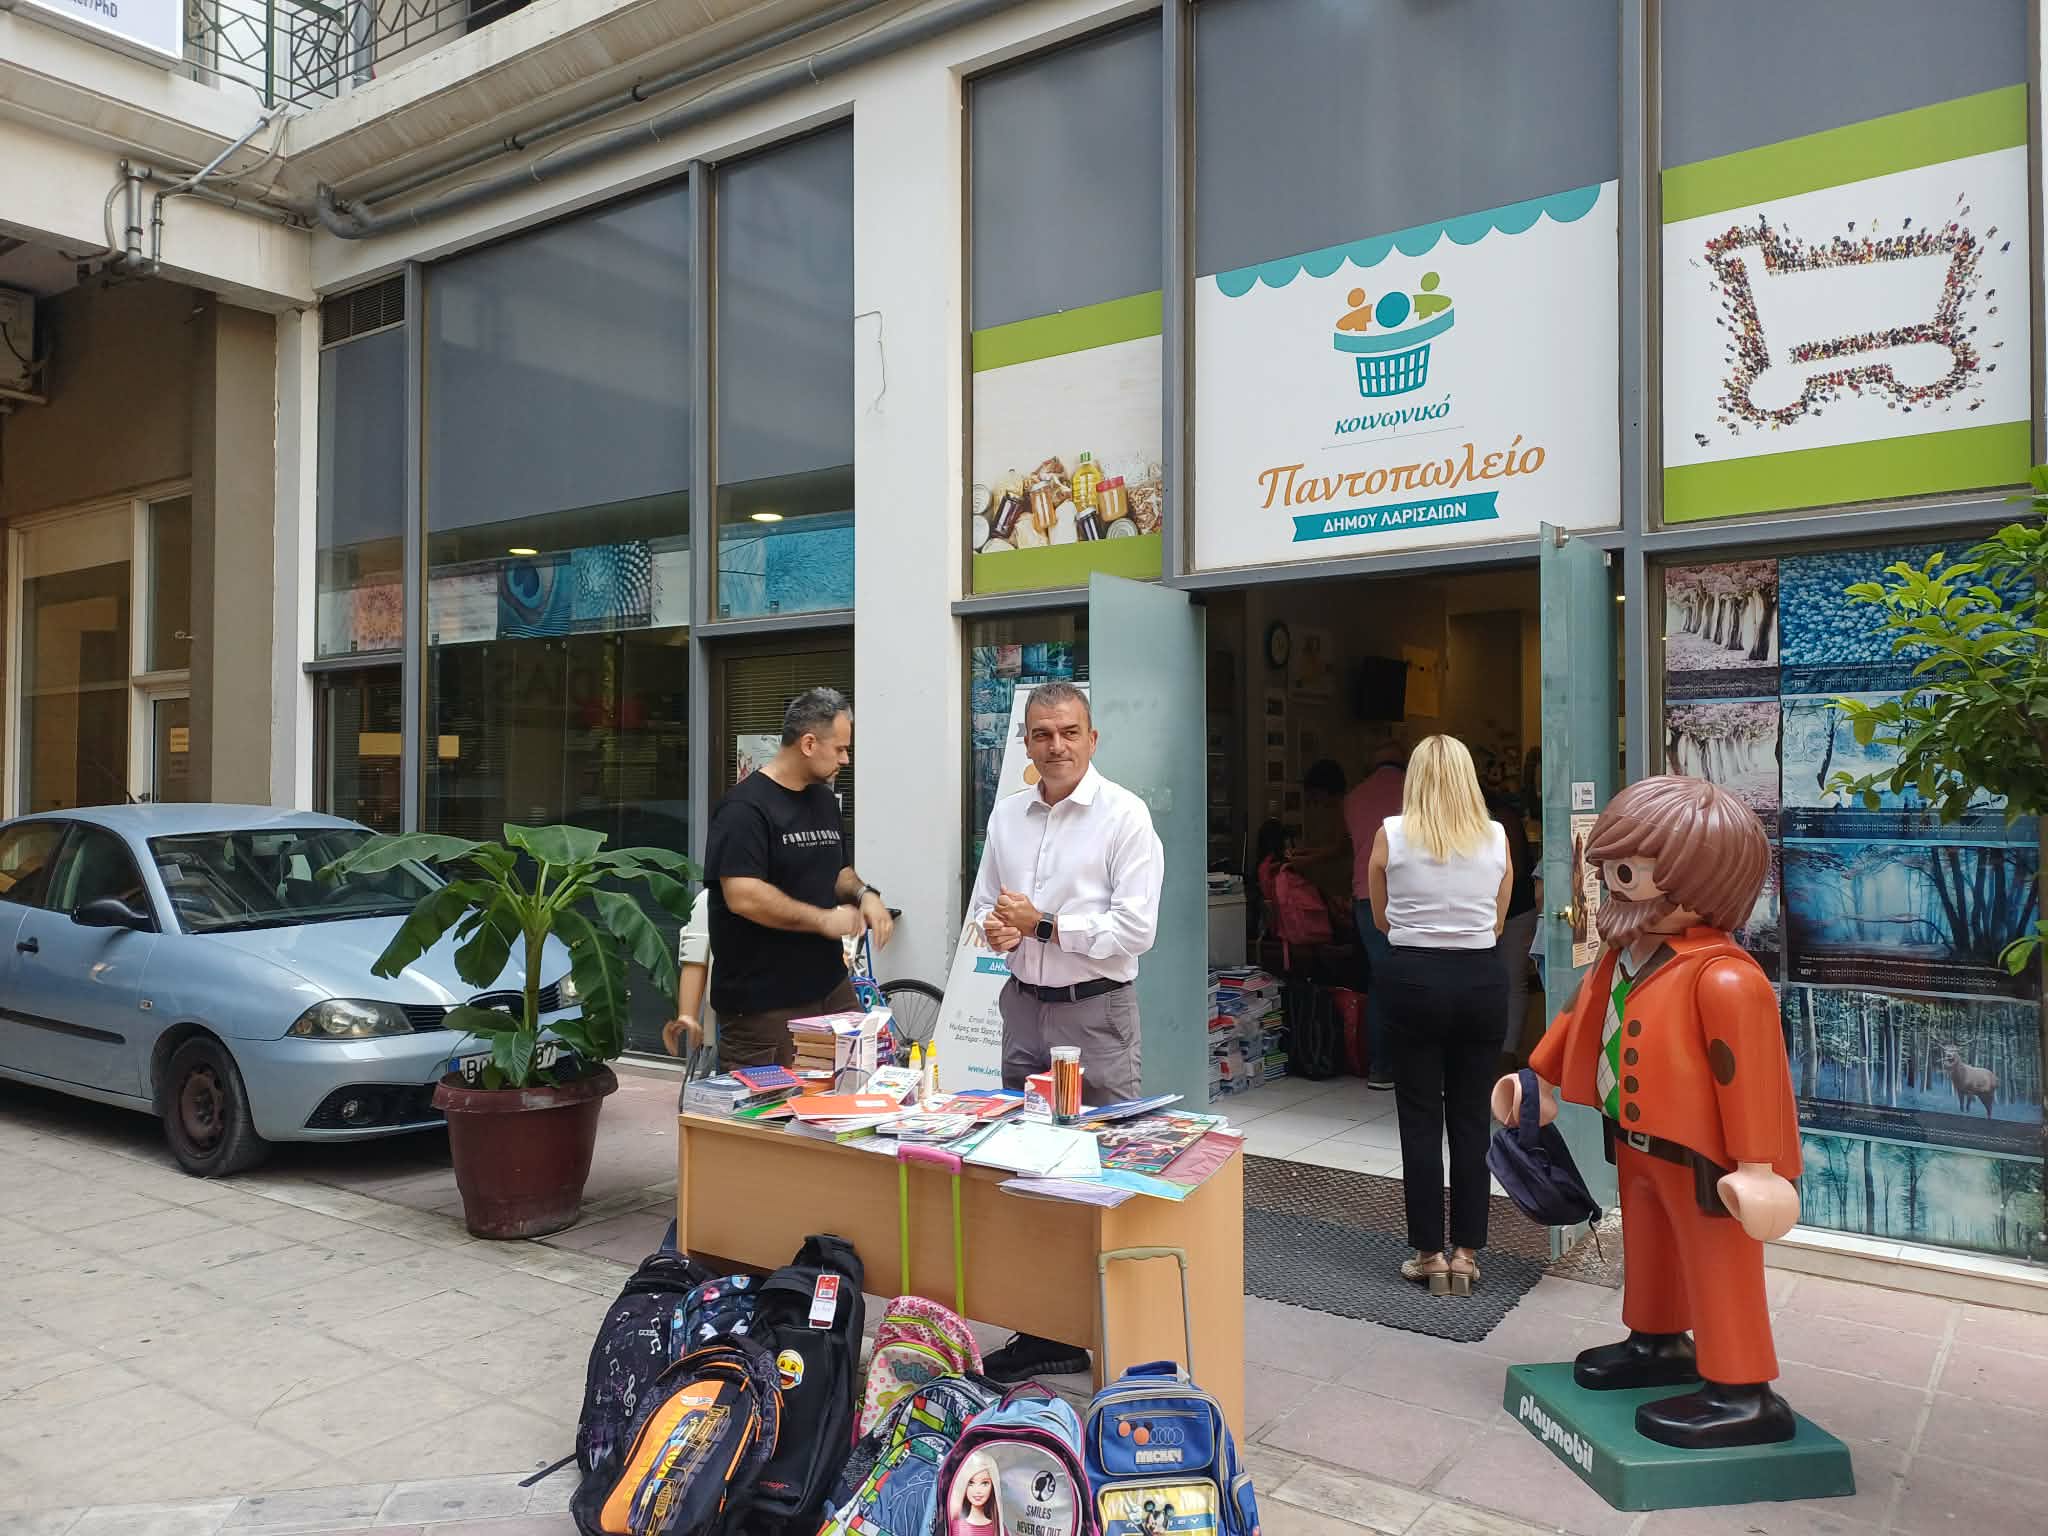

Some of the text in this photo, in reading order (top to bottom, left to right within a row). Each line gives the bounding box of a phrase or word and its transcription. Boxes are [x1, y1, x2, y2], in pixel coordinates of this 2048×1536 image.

[1334, 393, 1452, 435] κοινωνικό
[1258, 434, 1546, 510] Παντοπωλείο
[1322, 500, 1468, 533] ΔΗΜΟΥ ΛΑΡΙΣΑΙΩΝ
[1520, 1395, 1594, 1473] playmobil
[1016, 1520, 1036, 1536] NEVER
[1026, 1504, 1053, 1520] SMILES
